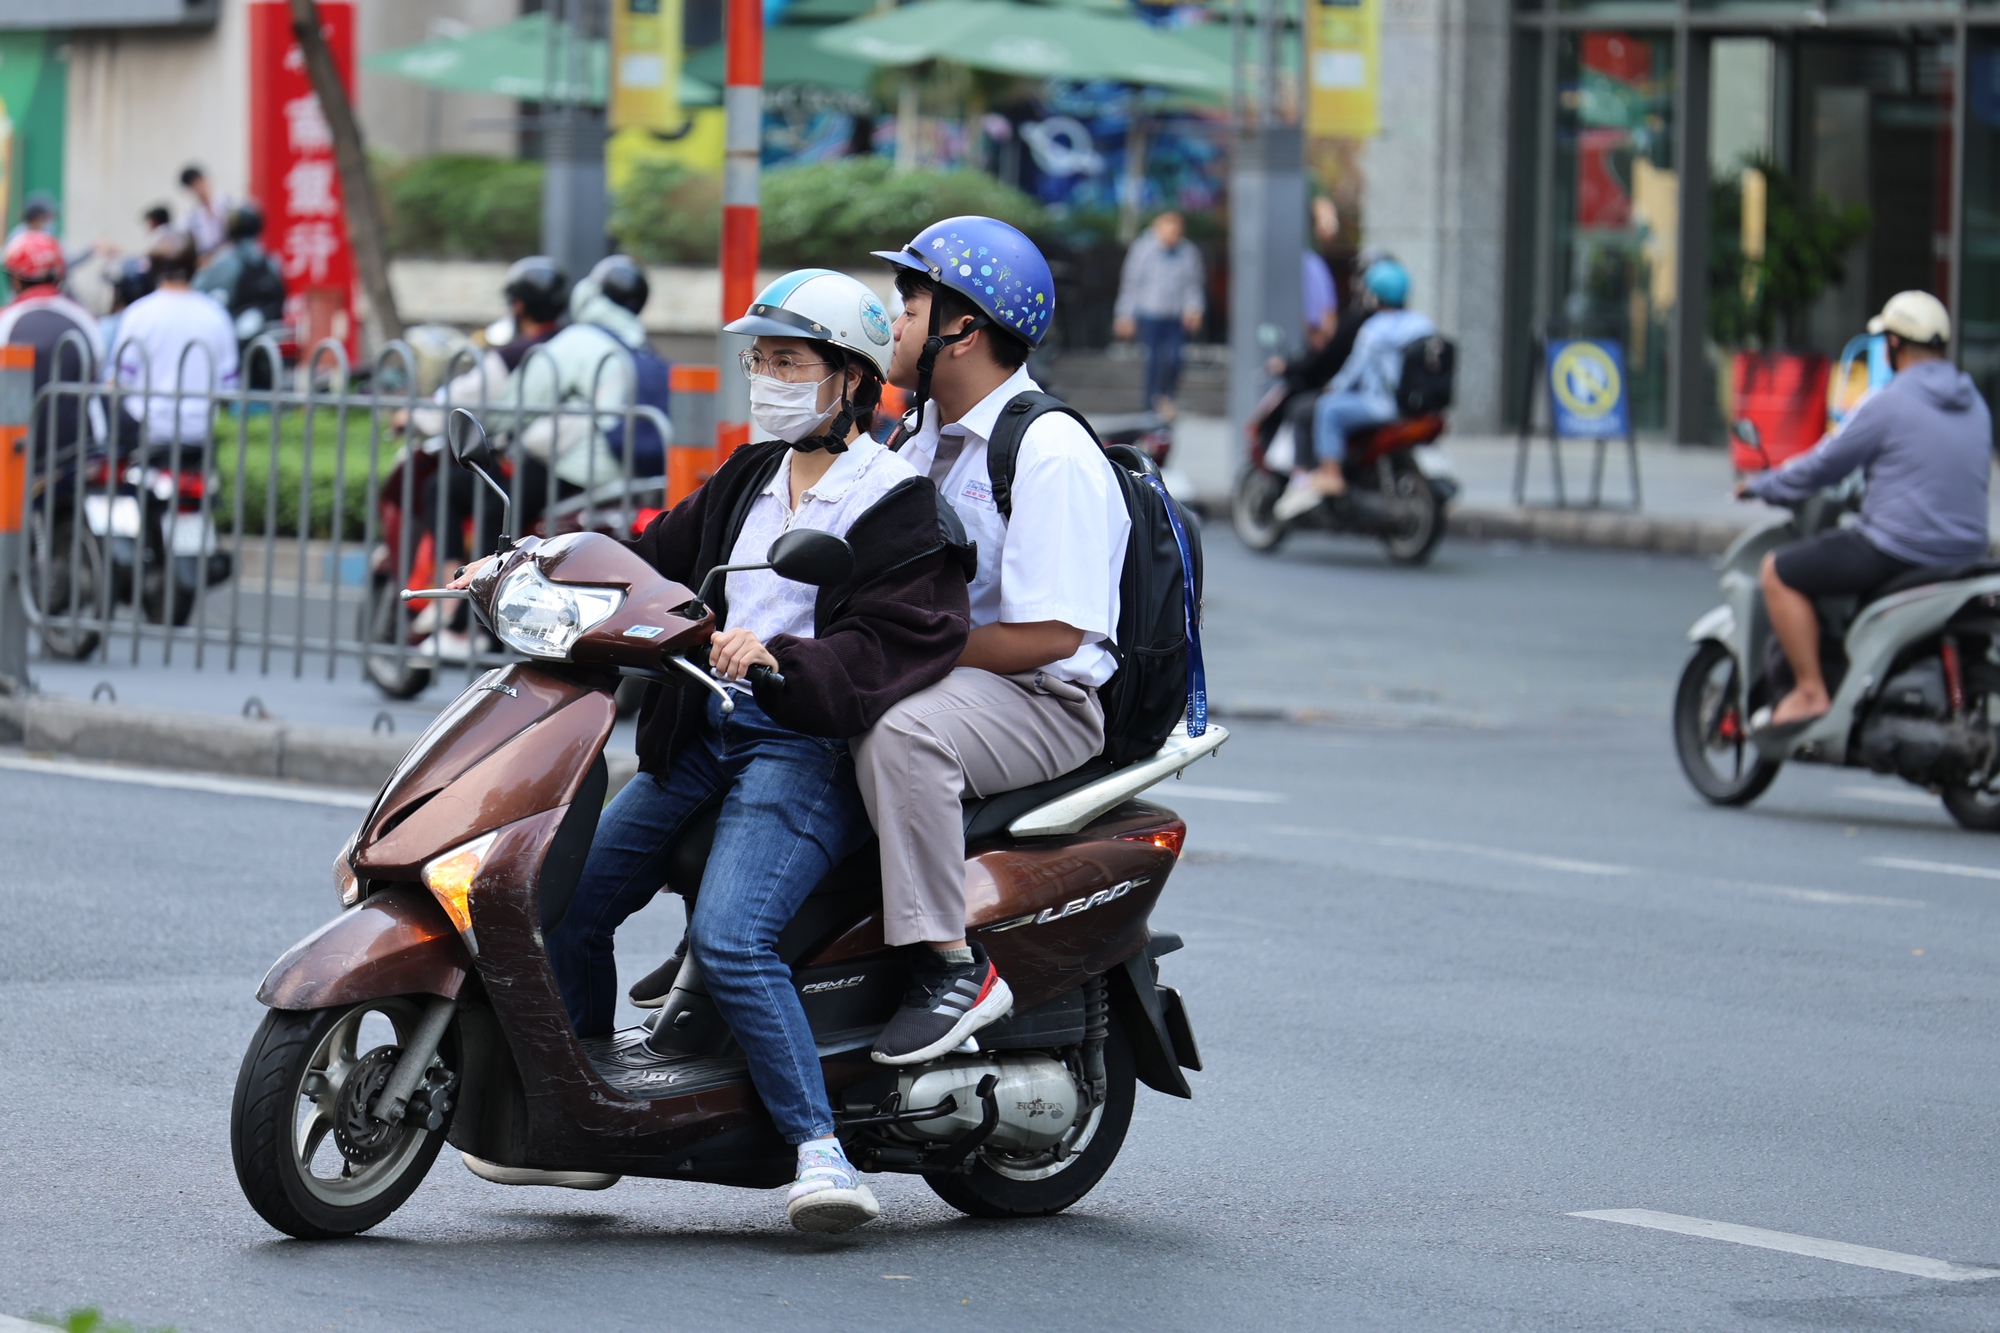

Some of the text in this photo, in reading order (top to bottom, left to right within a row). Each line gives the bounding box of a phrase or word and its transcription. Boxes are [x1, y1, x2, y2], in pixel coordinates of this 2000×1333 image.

[1196, 690, 1205, 719] CLUB
[1035, 880, 1133, 925] LEAD
[824, 982, 860, 992] INJECTION
[1015, 1101, 1064, 1110] HONDA
